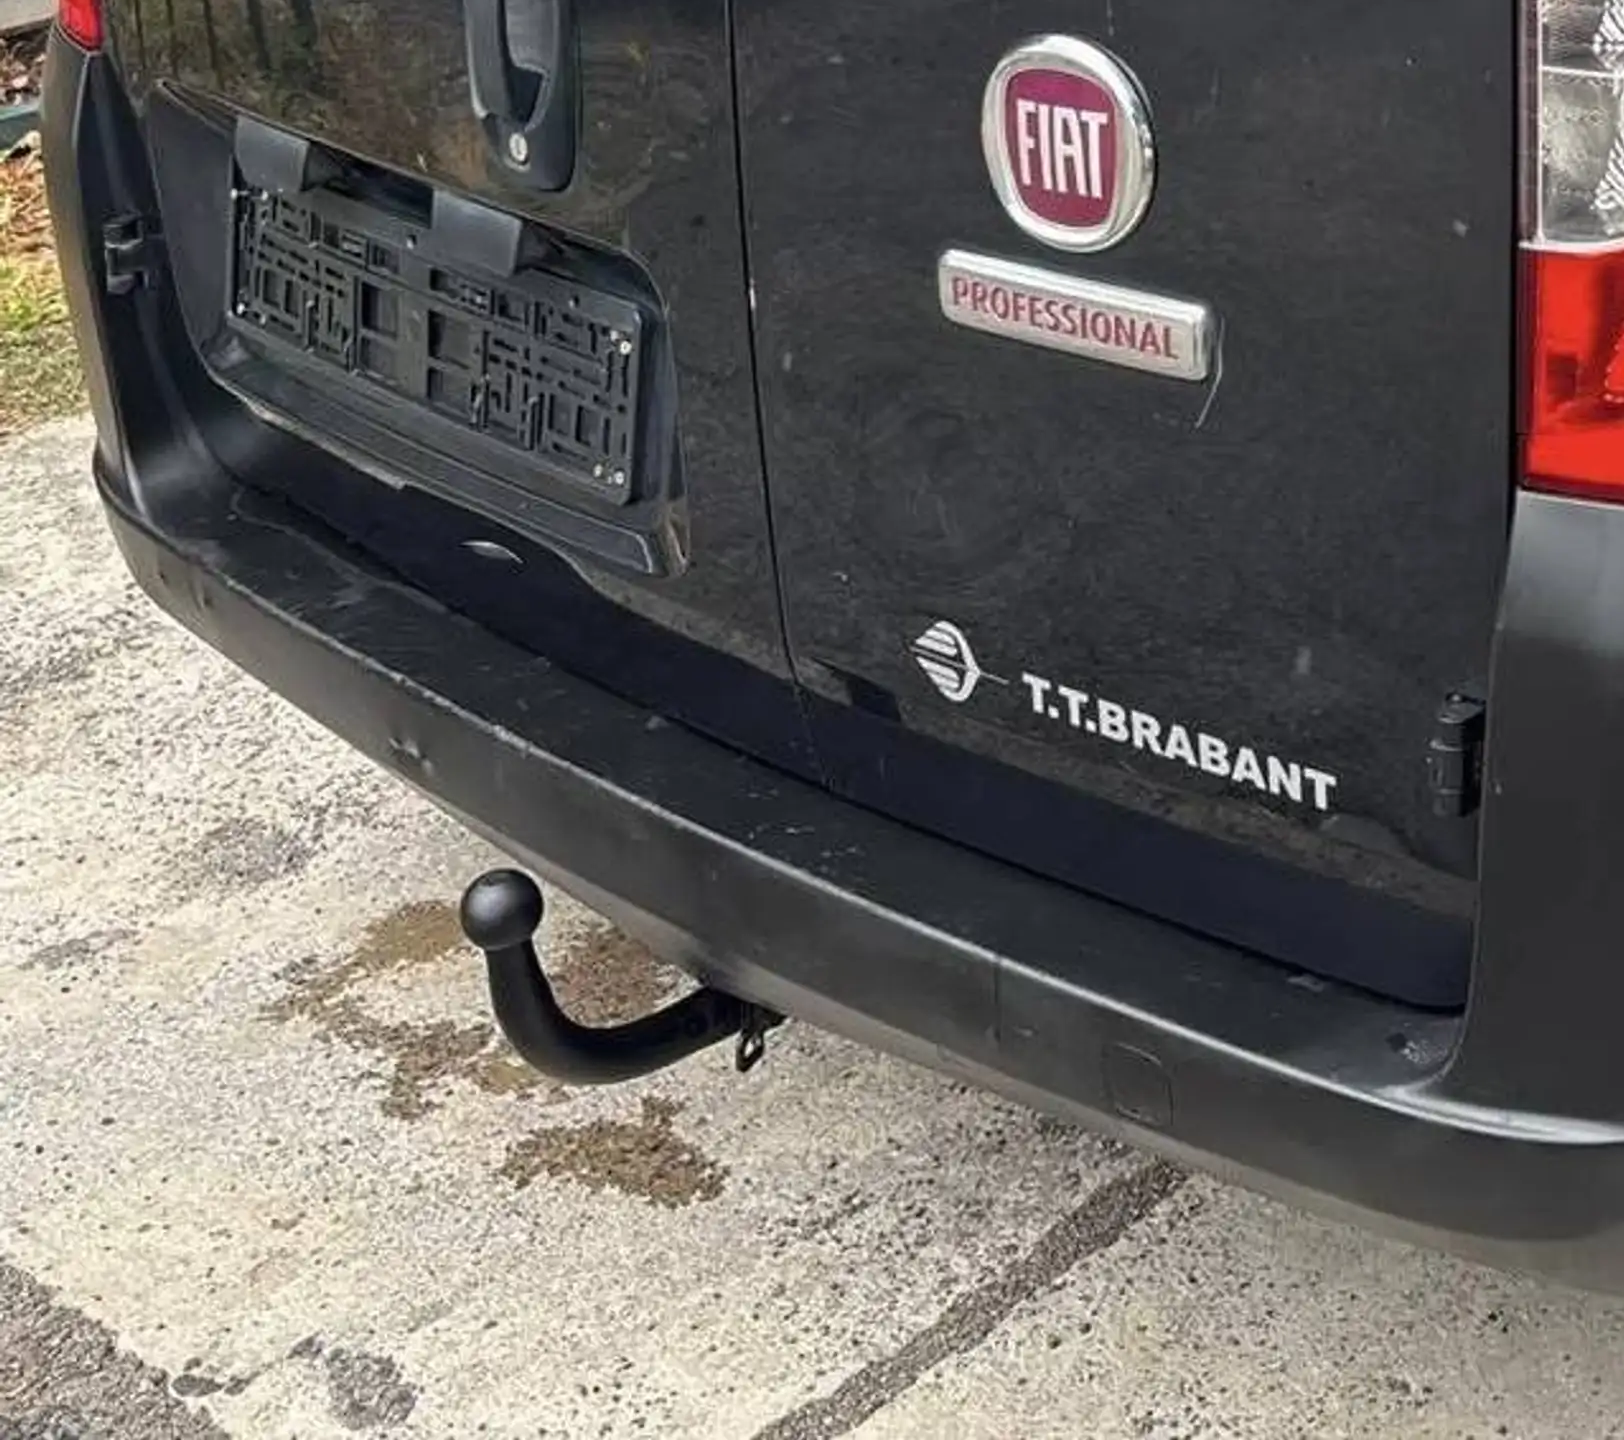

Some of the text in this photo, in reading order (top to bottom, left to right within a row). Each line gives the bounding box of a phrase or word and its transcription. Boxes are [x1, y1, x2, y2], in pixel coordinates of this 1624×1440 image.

[1015, 97, 1108, 199] FIAT
[950, 276, 1179, 360] PROFESSIONAL
[1021, 671, 1337, 811] T.T.BRABANT
